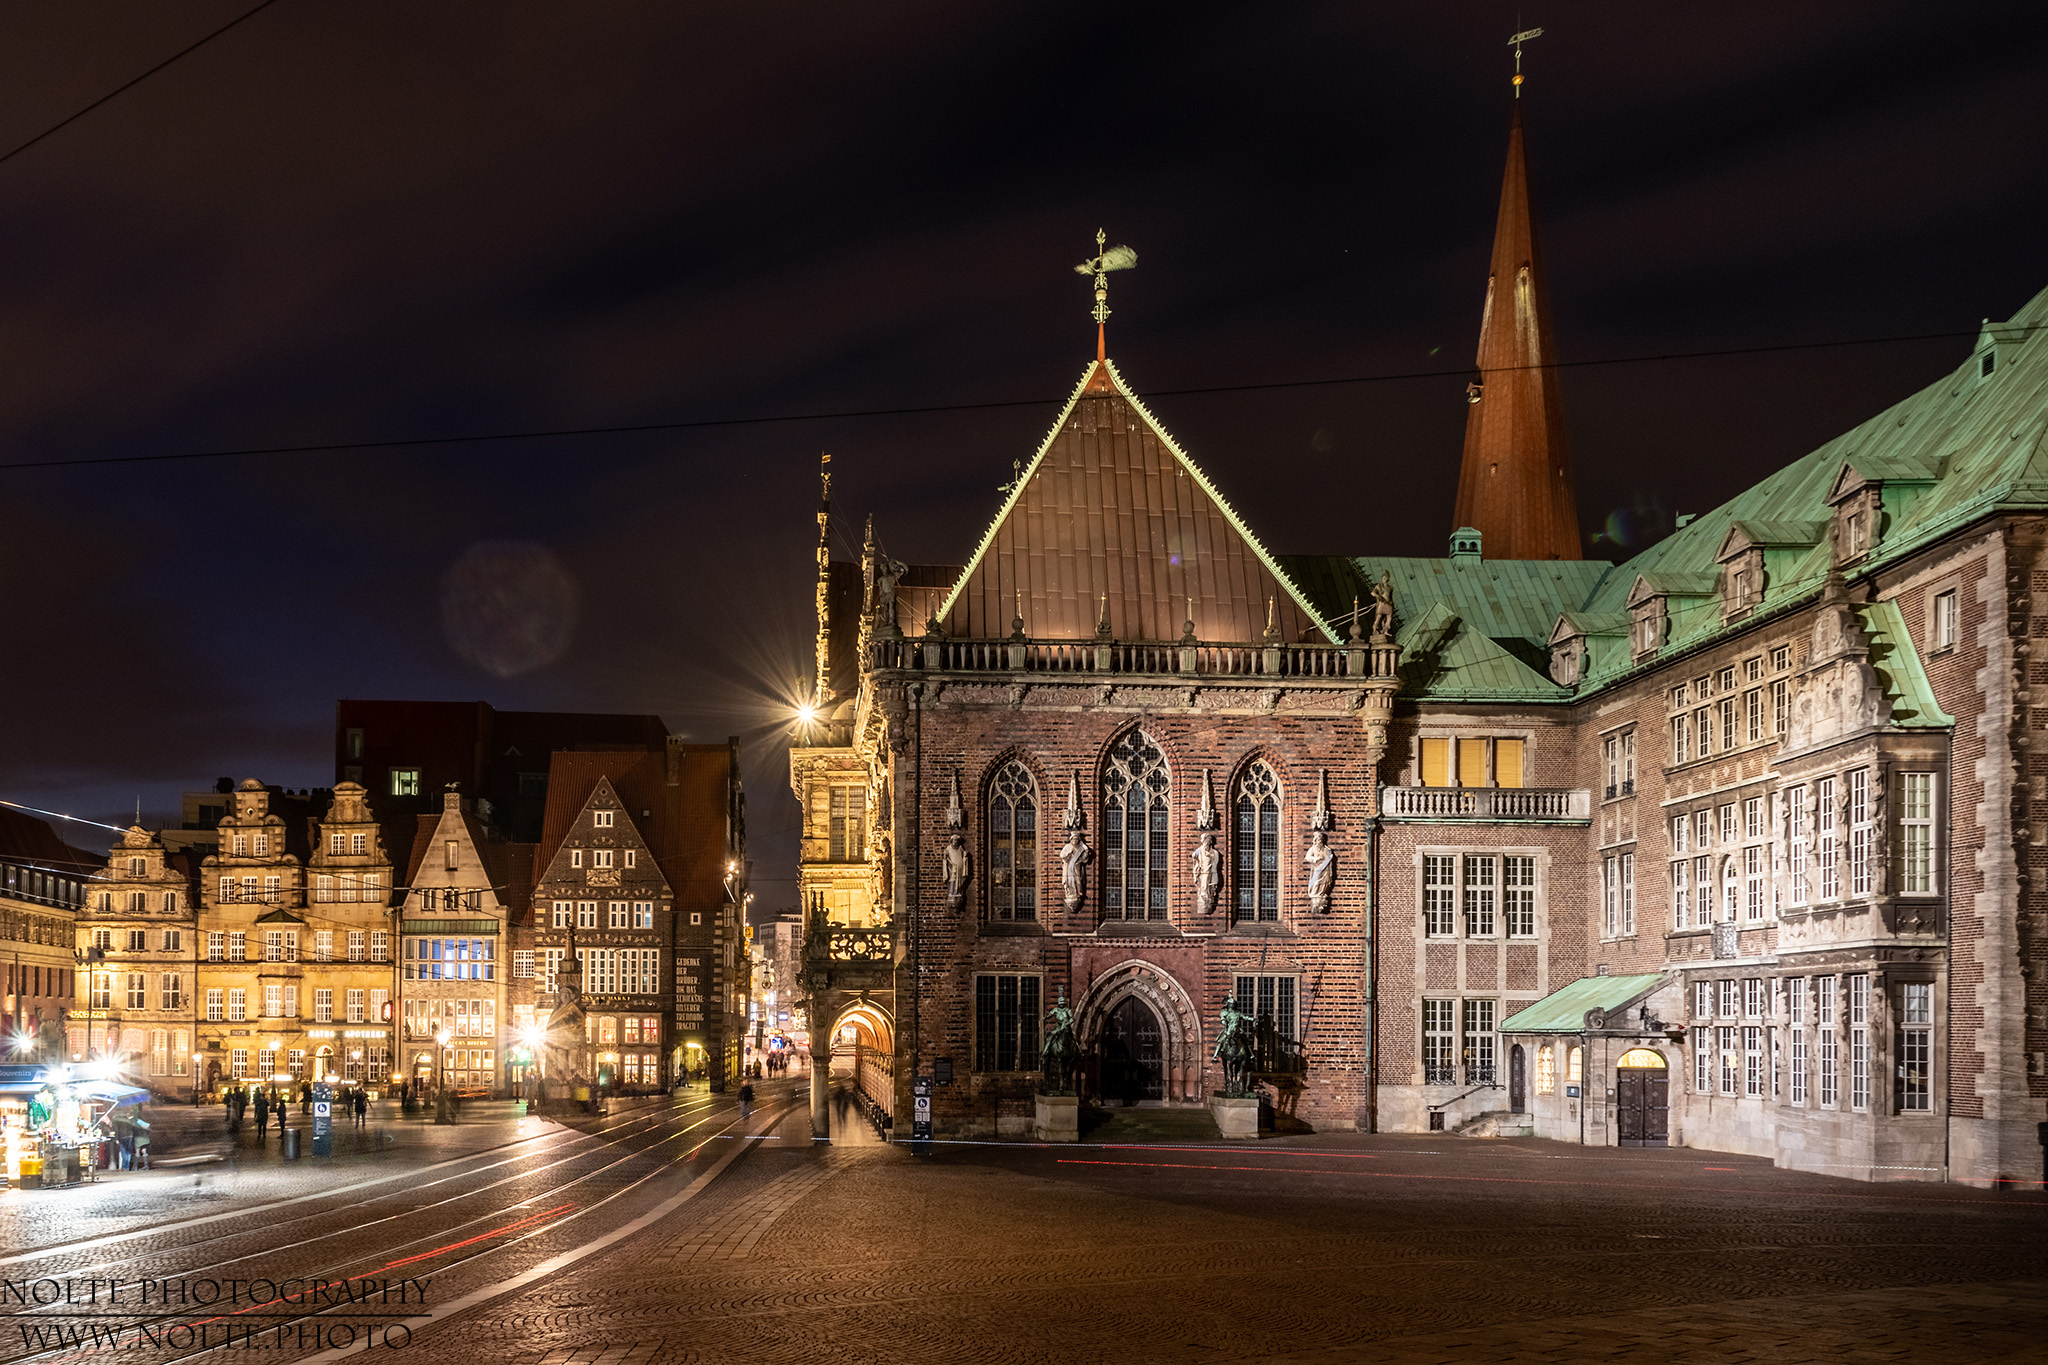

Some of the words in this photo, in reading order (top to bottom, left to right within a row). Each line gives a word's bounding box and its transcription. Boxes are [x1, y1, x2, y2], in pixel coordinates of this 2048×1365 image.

[676, 957, 700, 966] GEDENKE
[676, 967, 687, 975] DER
[686, 985, 697, 993] DAS
[676, 994, 704, 1002] SCHICKSAL
[676, 1004, 701, 1012] UNSERER
[676, 1013, 704, 1021] TRENNUNG
